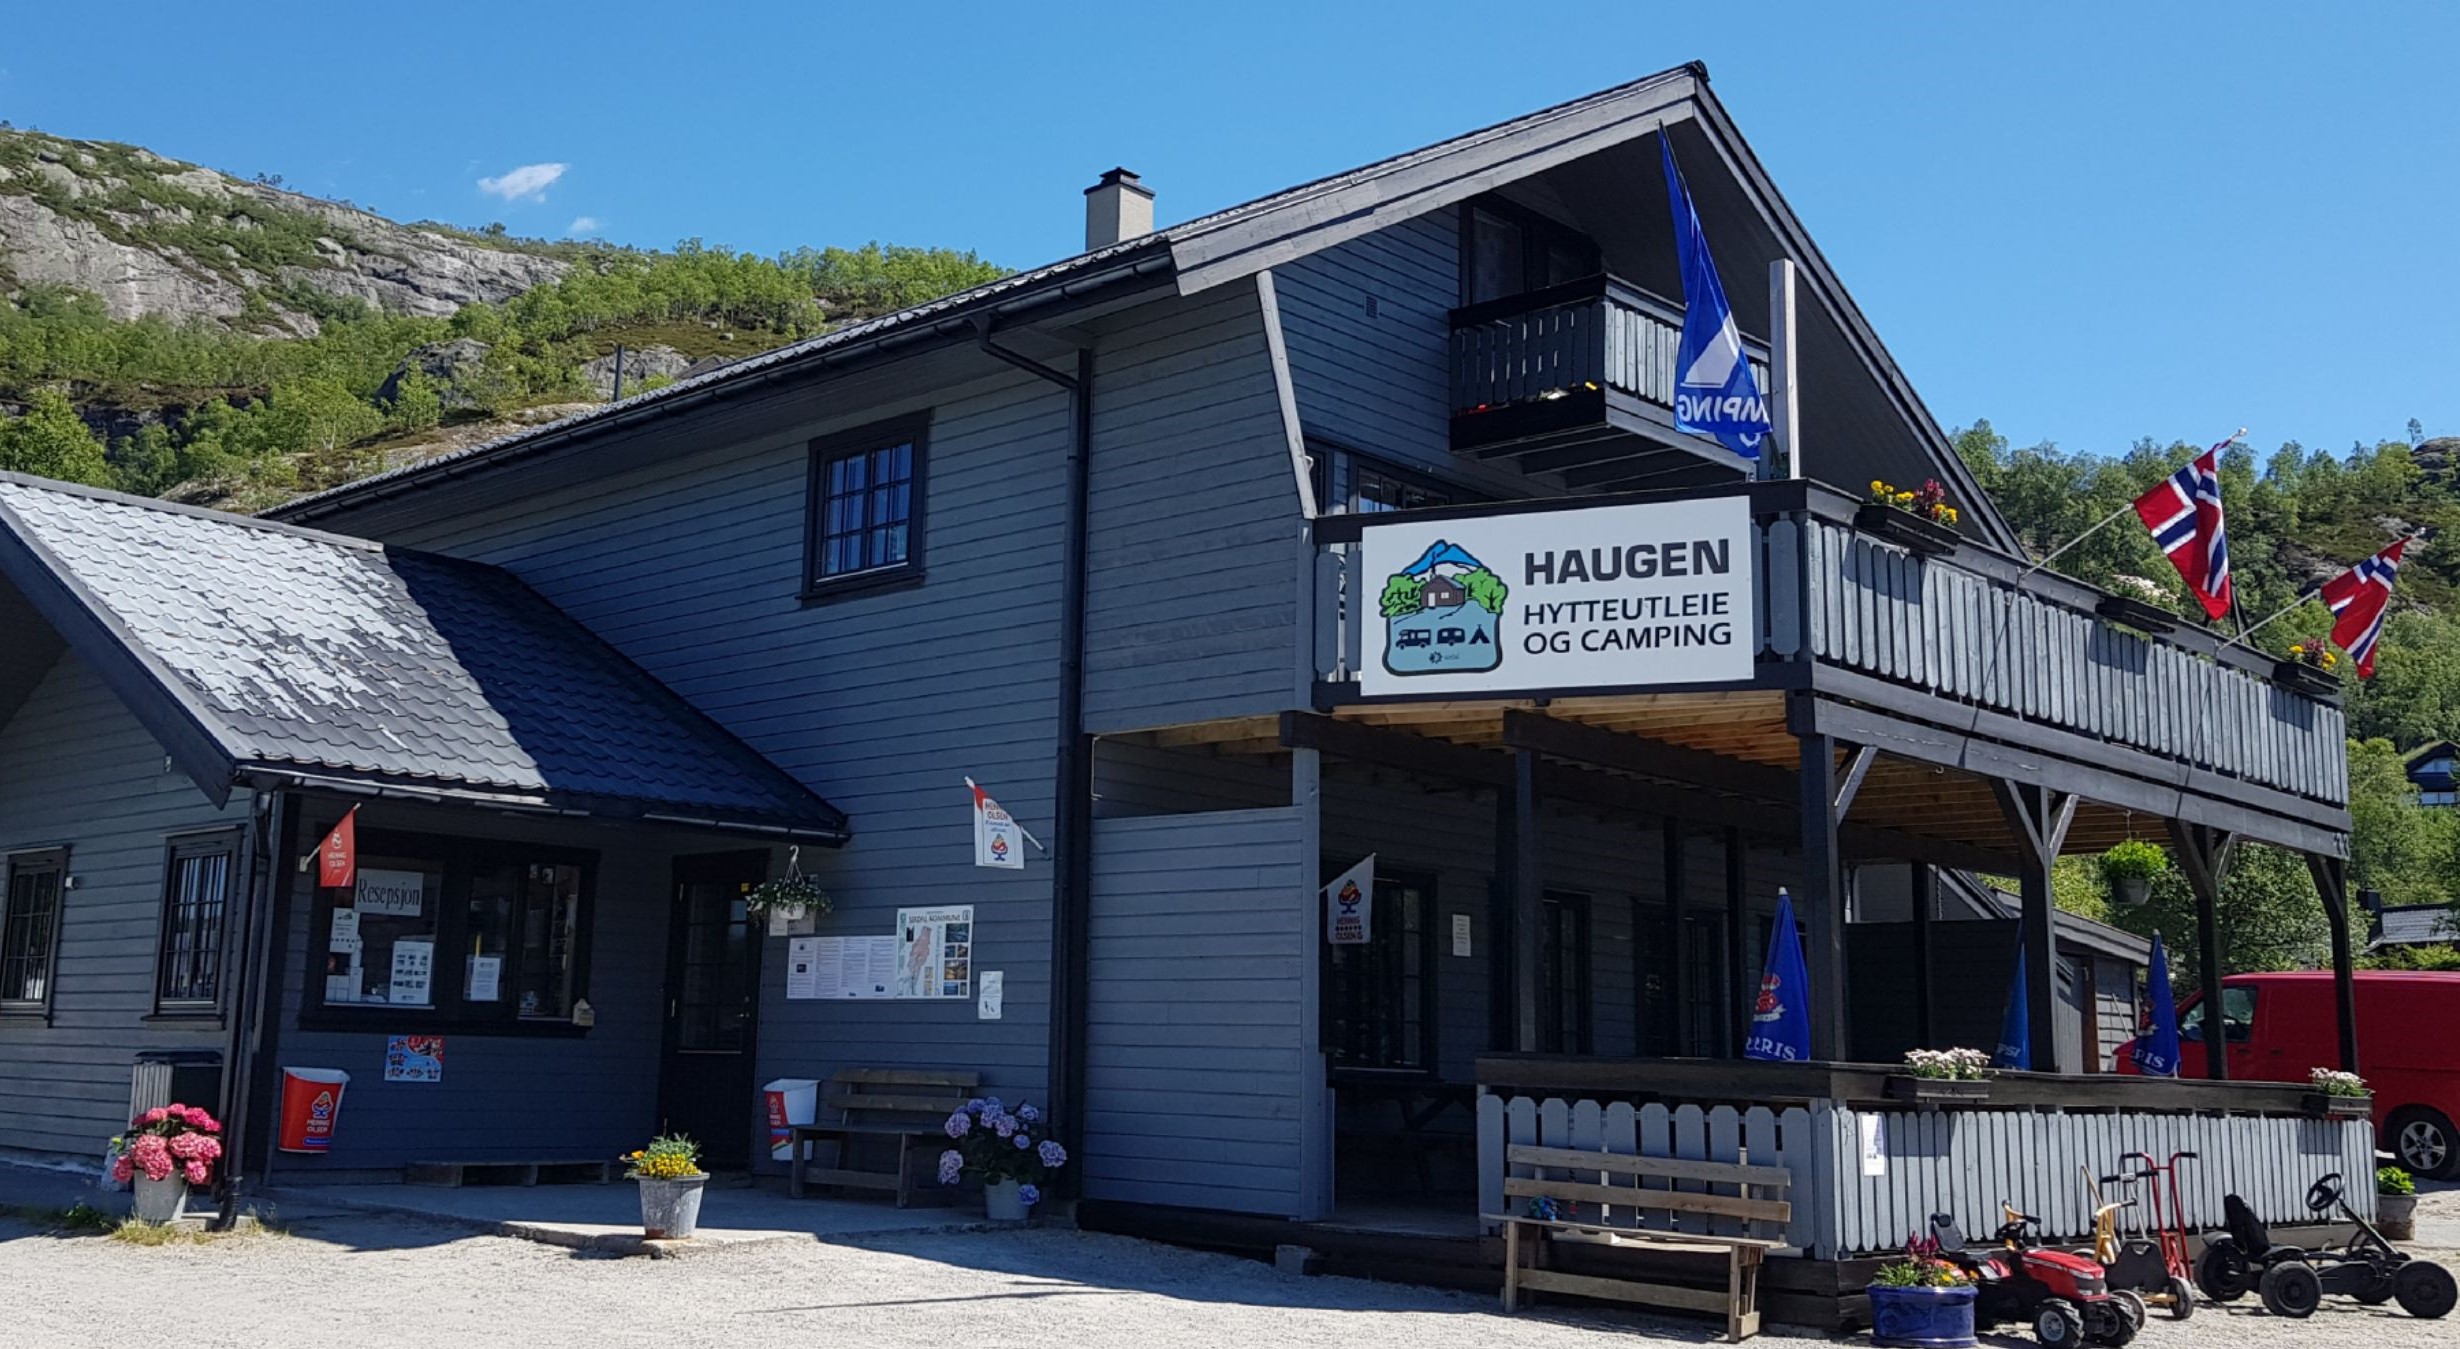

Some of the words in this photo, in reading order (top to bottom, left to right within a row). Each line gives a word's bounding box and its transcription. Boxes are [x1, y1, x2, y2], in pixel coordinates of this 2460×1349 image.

[1524, 538, 1730, 586] HAUGEN
[1523, 592, 1730, 626] HYTTEUTLEIE
[1523, 631, 1571, 655] OG
[1581, 622, 1732, 652] CAMPING
[358, 878, 420, 910] Resepsjon
